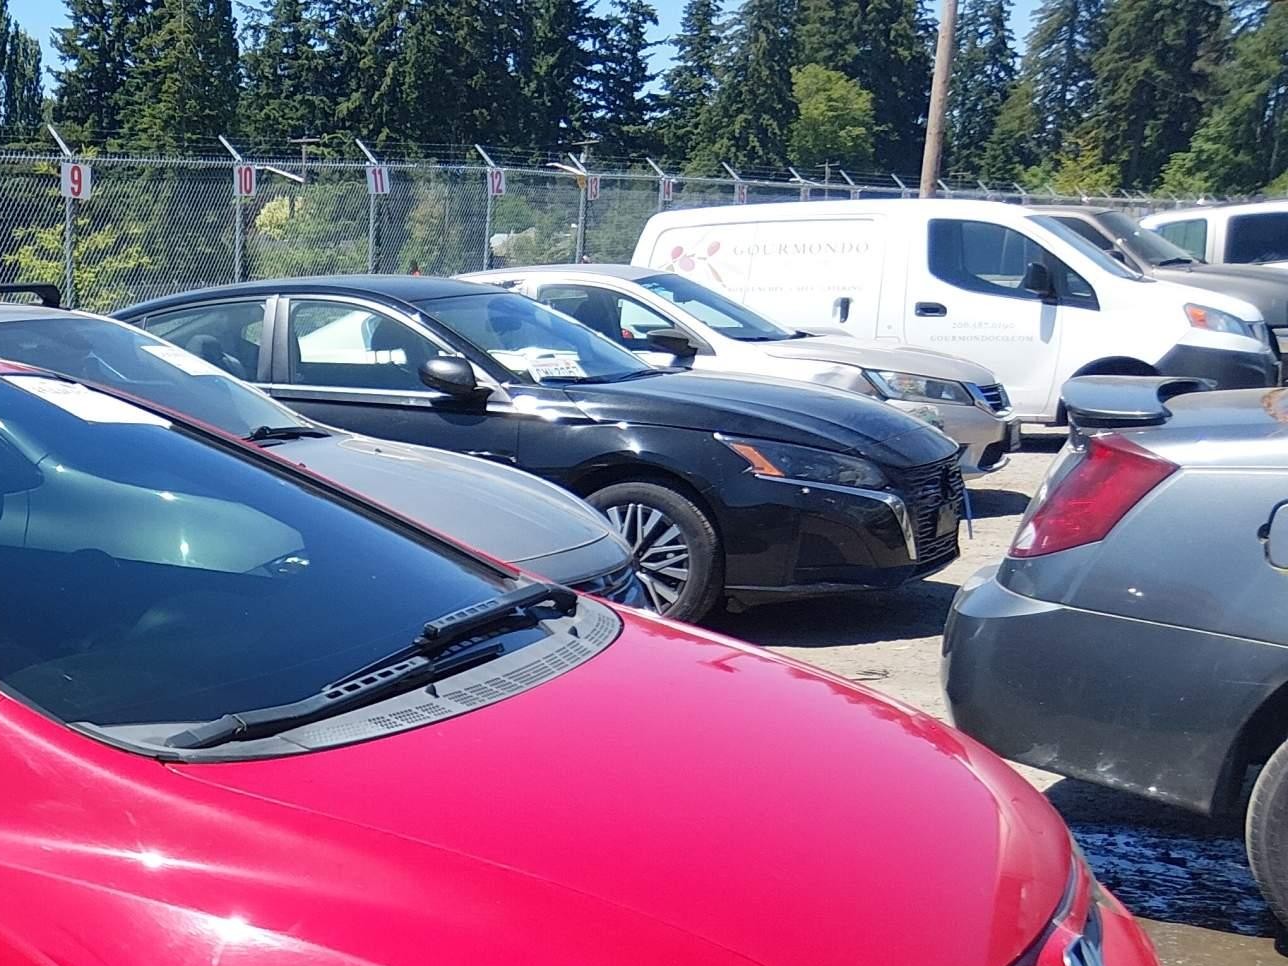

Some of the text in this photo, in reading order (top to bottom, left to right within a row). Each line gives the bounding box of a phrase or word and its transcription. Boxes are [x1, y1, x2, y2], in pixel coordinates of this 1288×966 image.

[71, 166, 82, 197] 9
[239, 168, 253, 194] 10
[372, 168, 384, 193] 11
[490, 171, 503, 194] 12
[589, 177, 599, 198] 13
[732, 242, 870, 256] GOURMONDO
